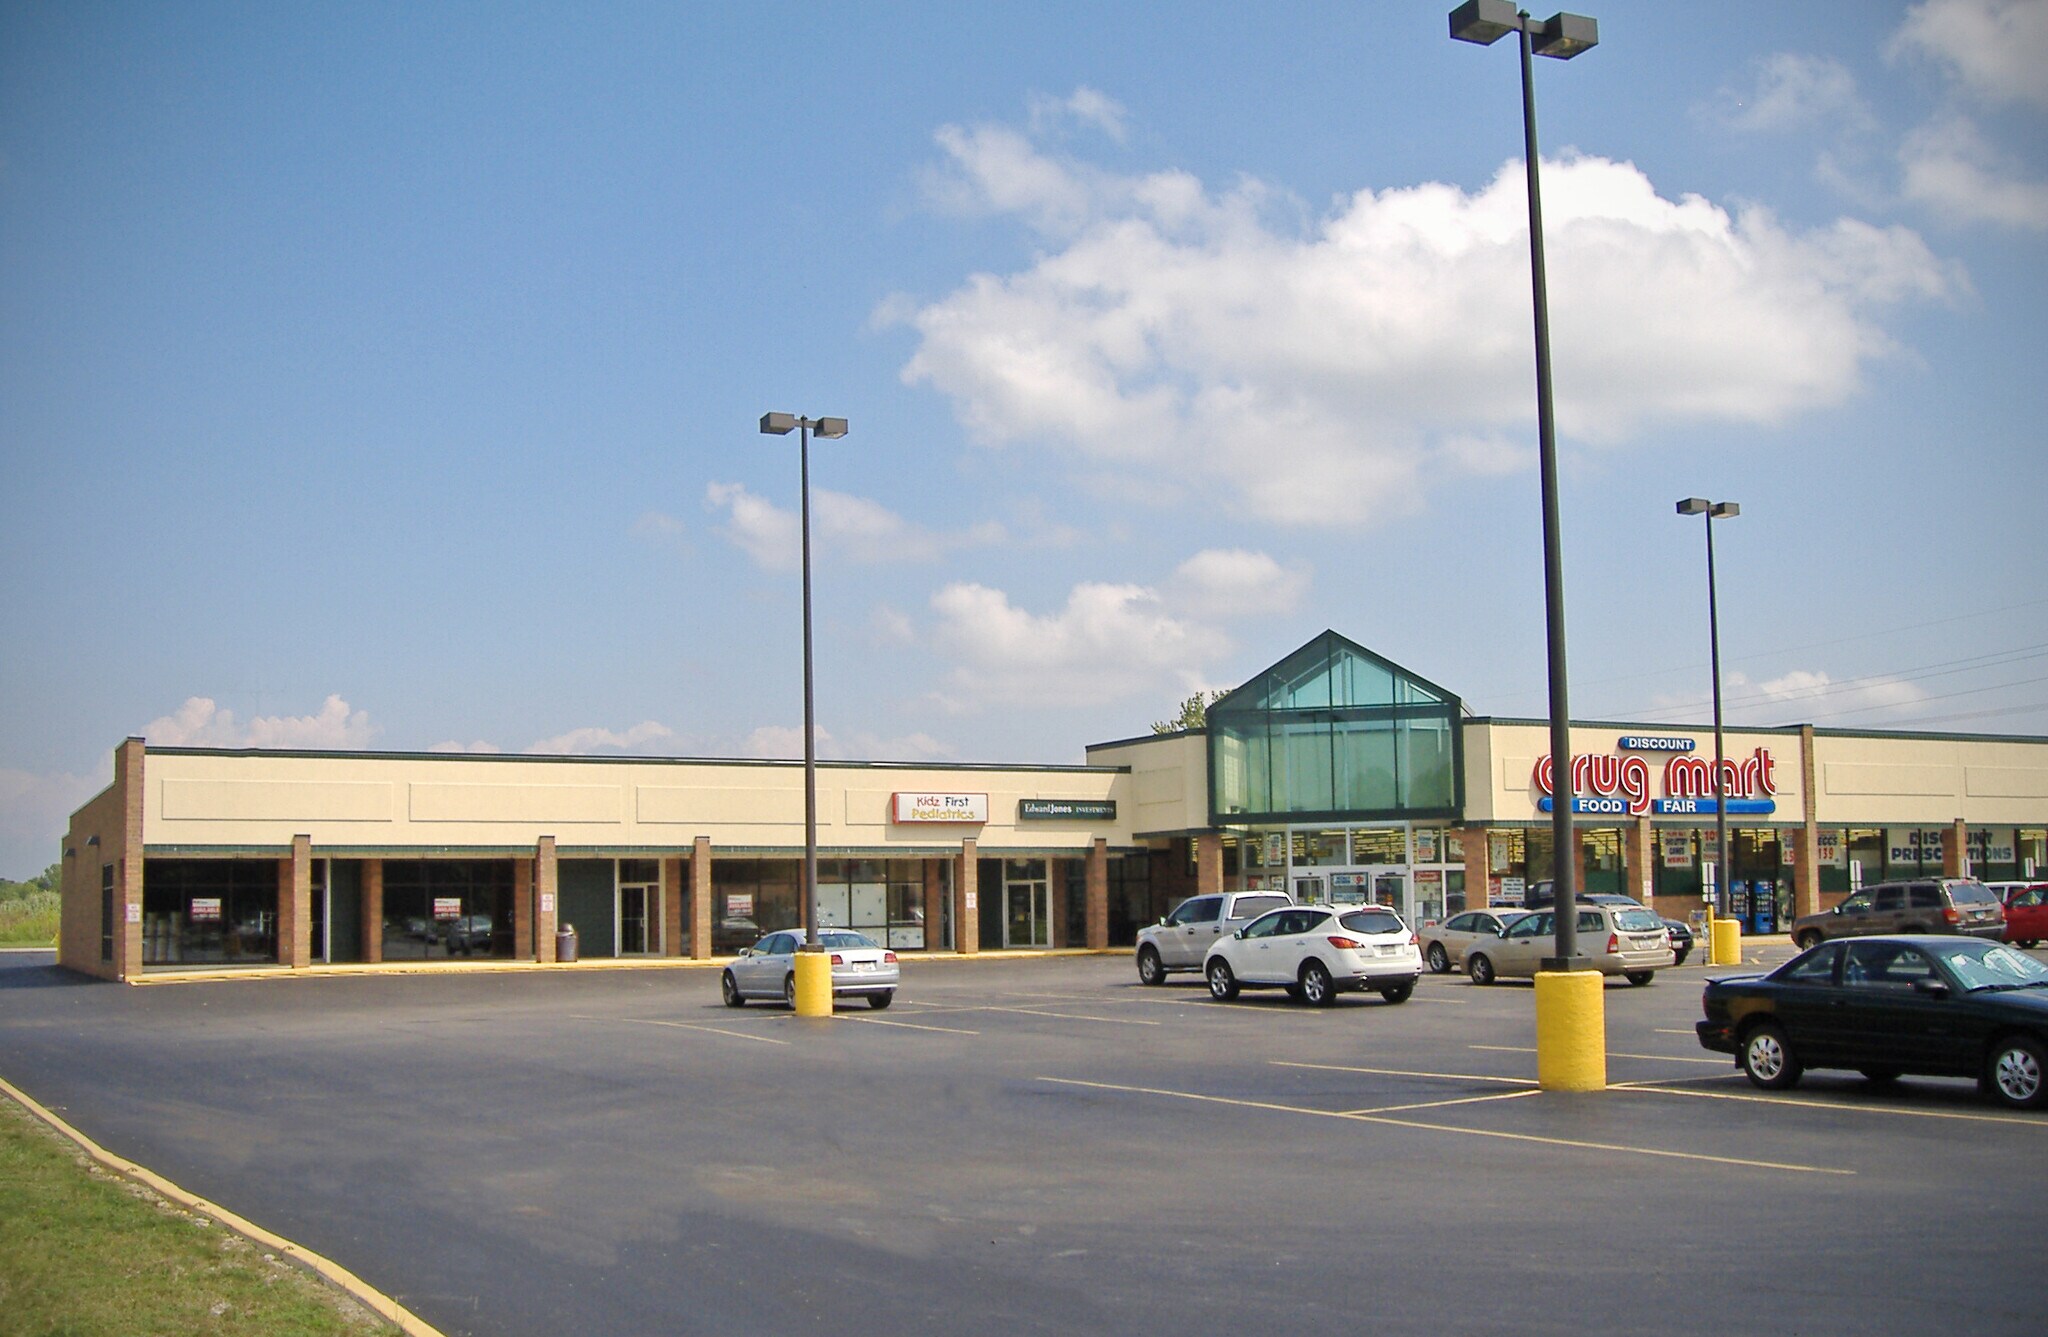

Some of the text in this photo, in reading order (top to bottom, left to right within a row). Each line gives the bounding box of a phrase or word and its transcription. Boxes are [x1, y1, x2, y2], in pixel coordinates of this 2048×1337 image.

[1628, 737, 1692, 750] DISCOUNT
[1665, 746, 1777, 798] mart
[916, 796, 969, 807] Kidz First
[1578, 799, 1697, 813] FOOD FAIR
[911, 808, 975, 820] Pediatrics
[1909, 832, 1993, 845] DISUNT
[1891, 847, 2012, 861] PRESCTIONS
